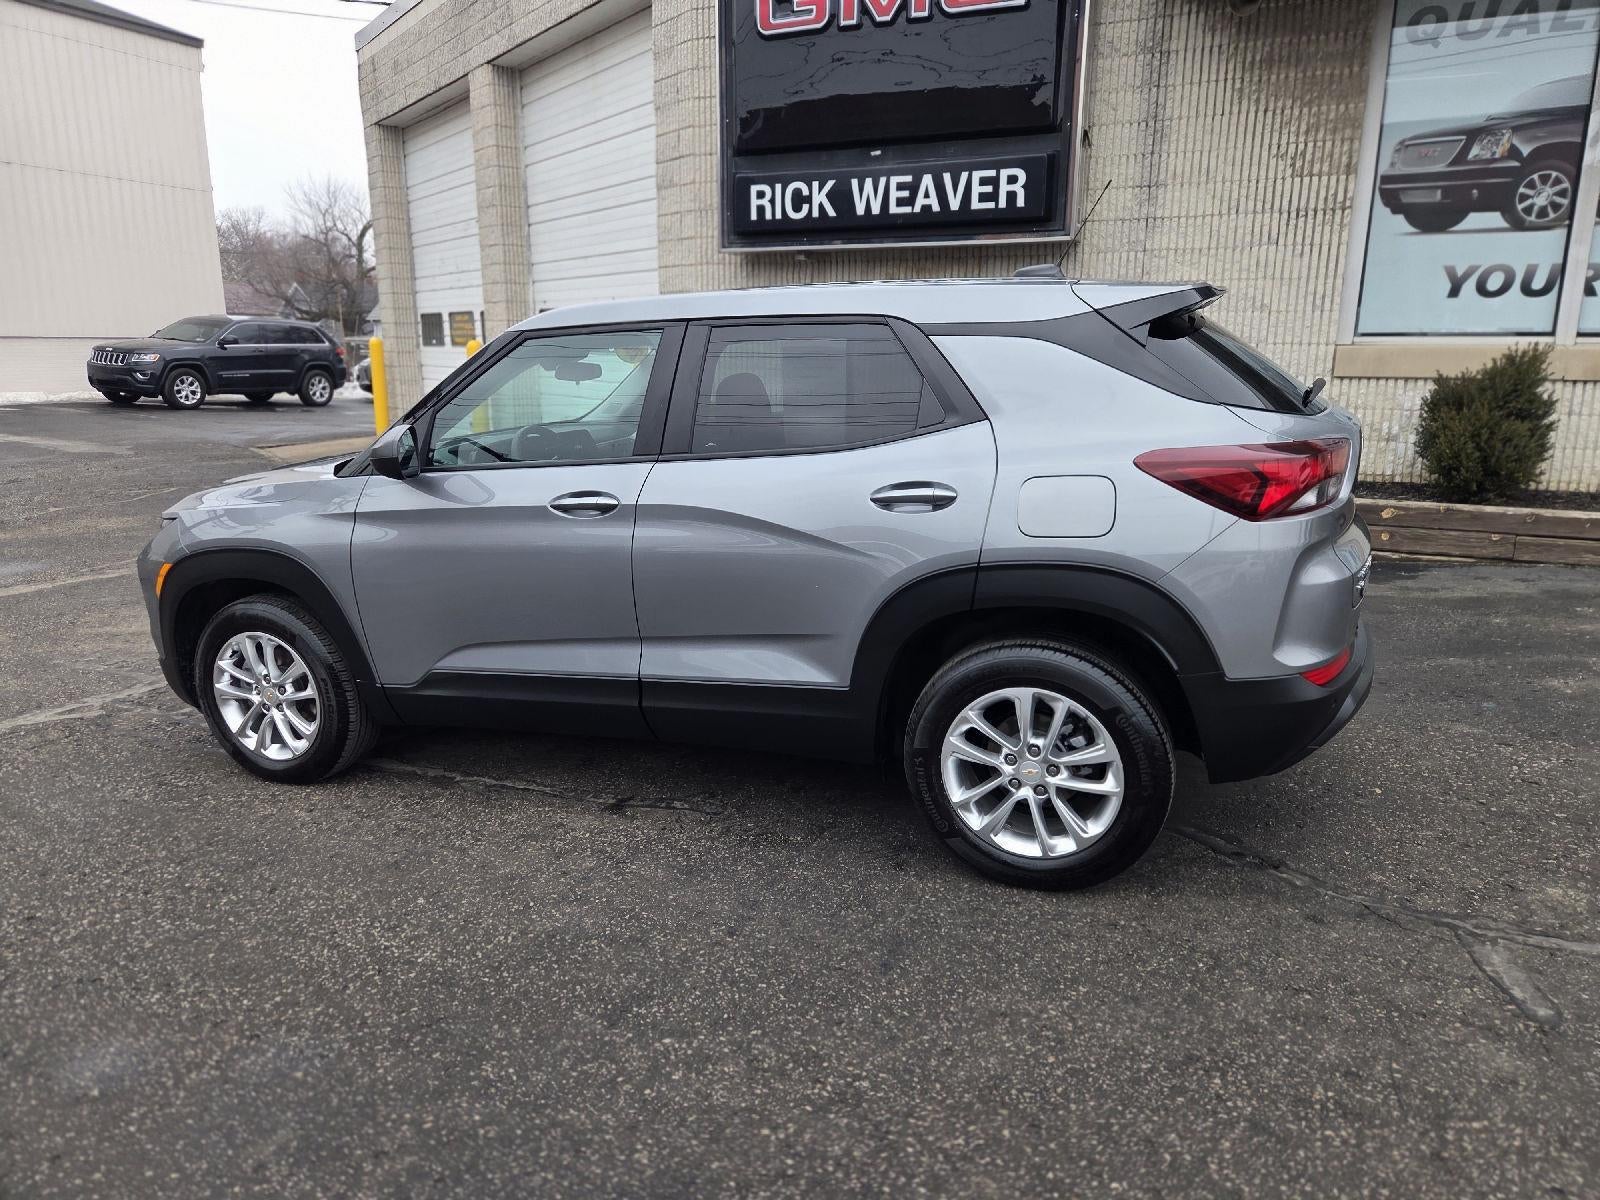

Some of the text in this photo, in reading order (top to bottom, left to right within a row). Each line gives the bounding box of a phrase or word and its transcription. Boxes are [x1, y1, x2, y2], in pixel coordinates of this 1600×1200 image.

[757, 0, 1028, 36] GM
[1406, 0, 1600, 48] QUAL
[750, 167, 1027, 221] RICK WEAVER
[1443, 263, 1600, 298] YOUR
